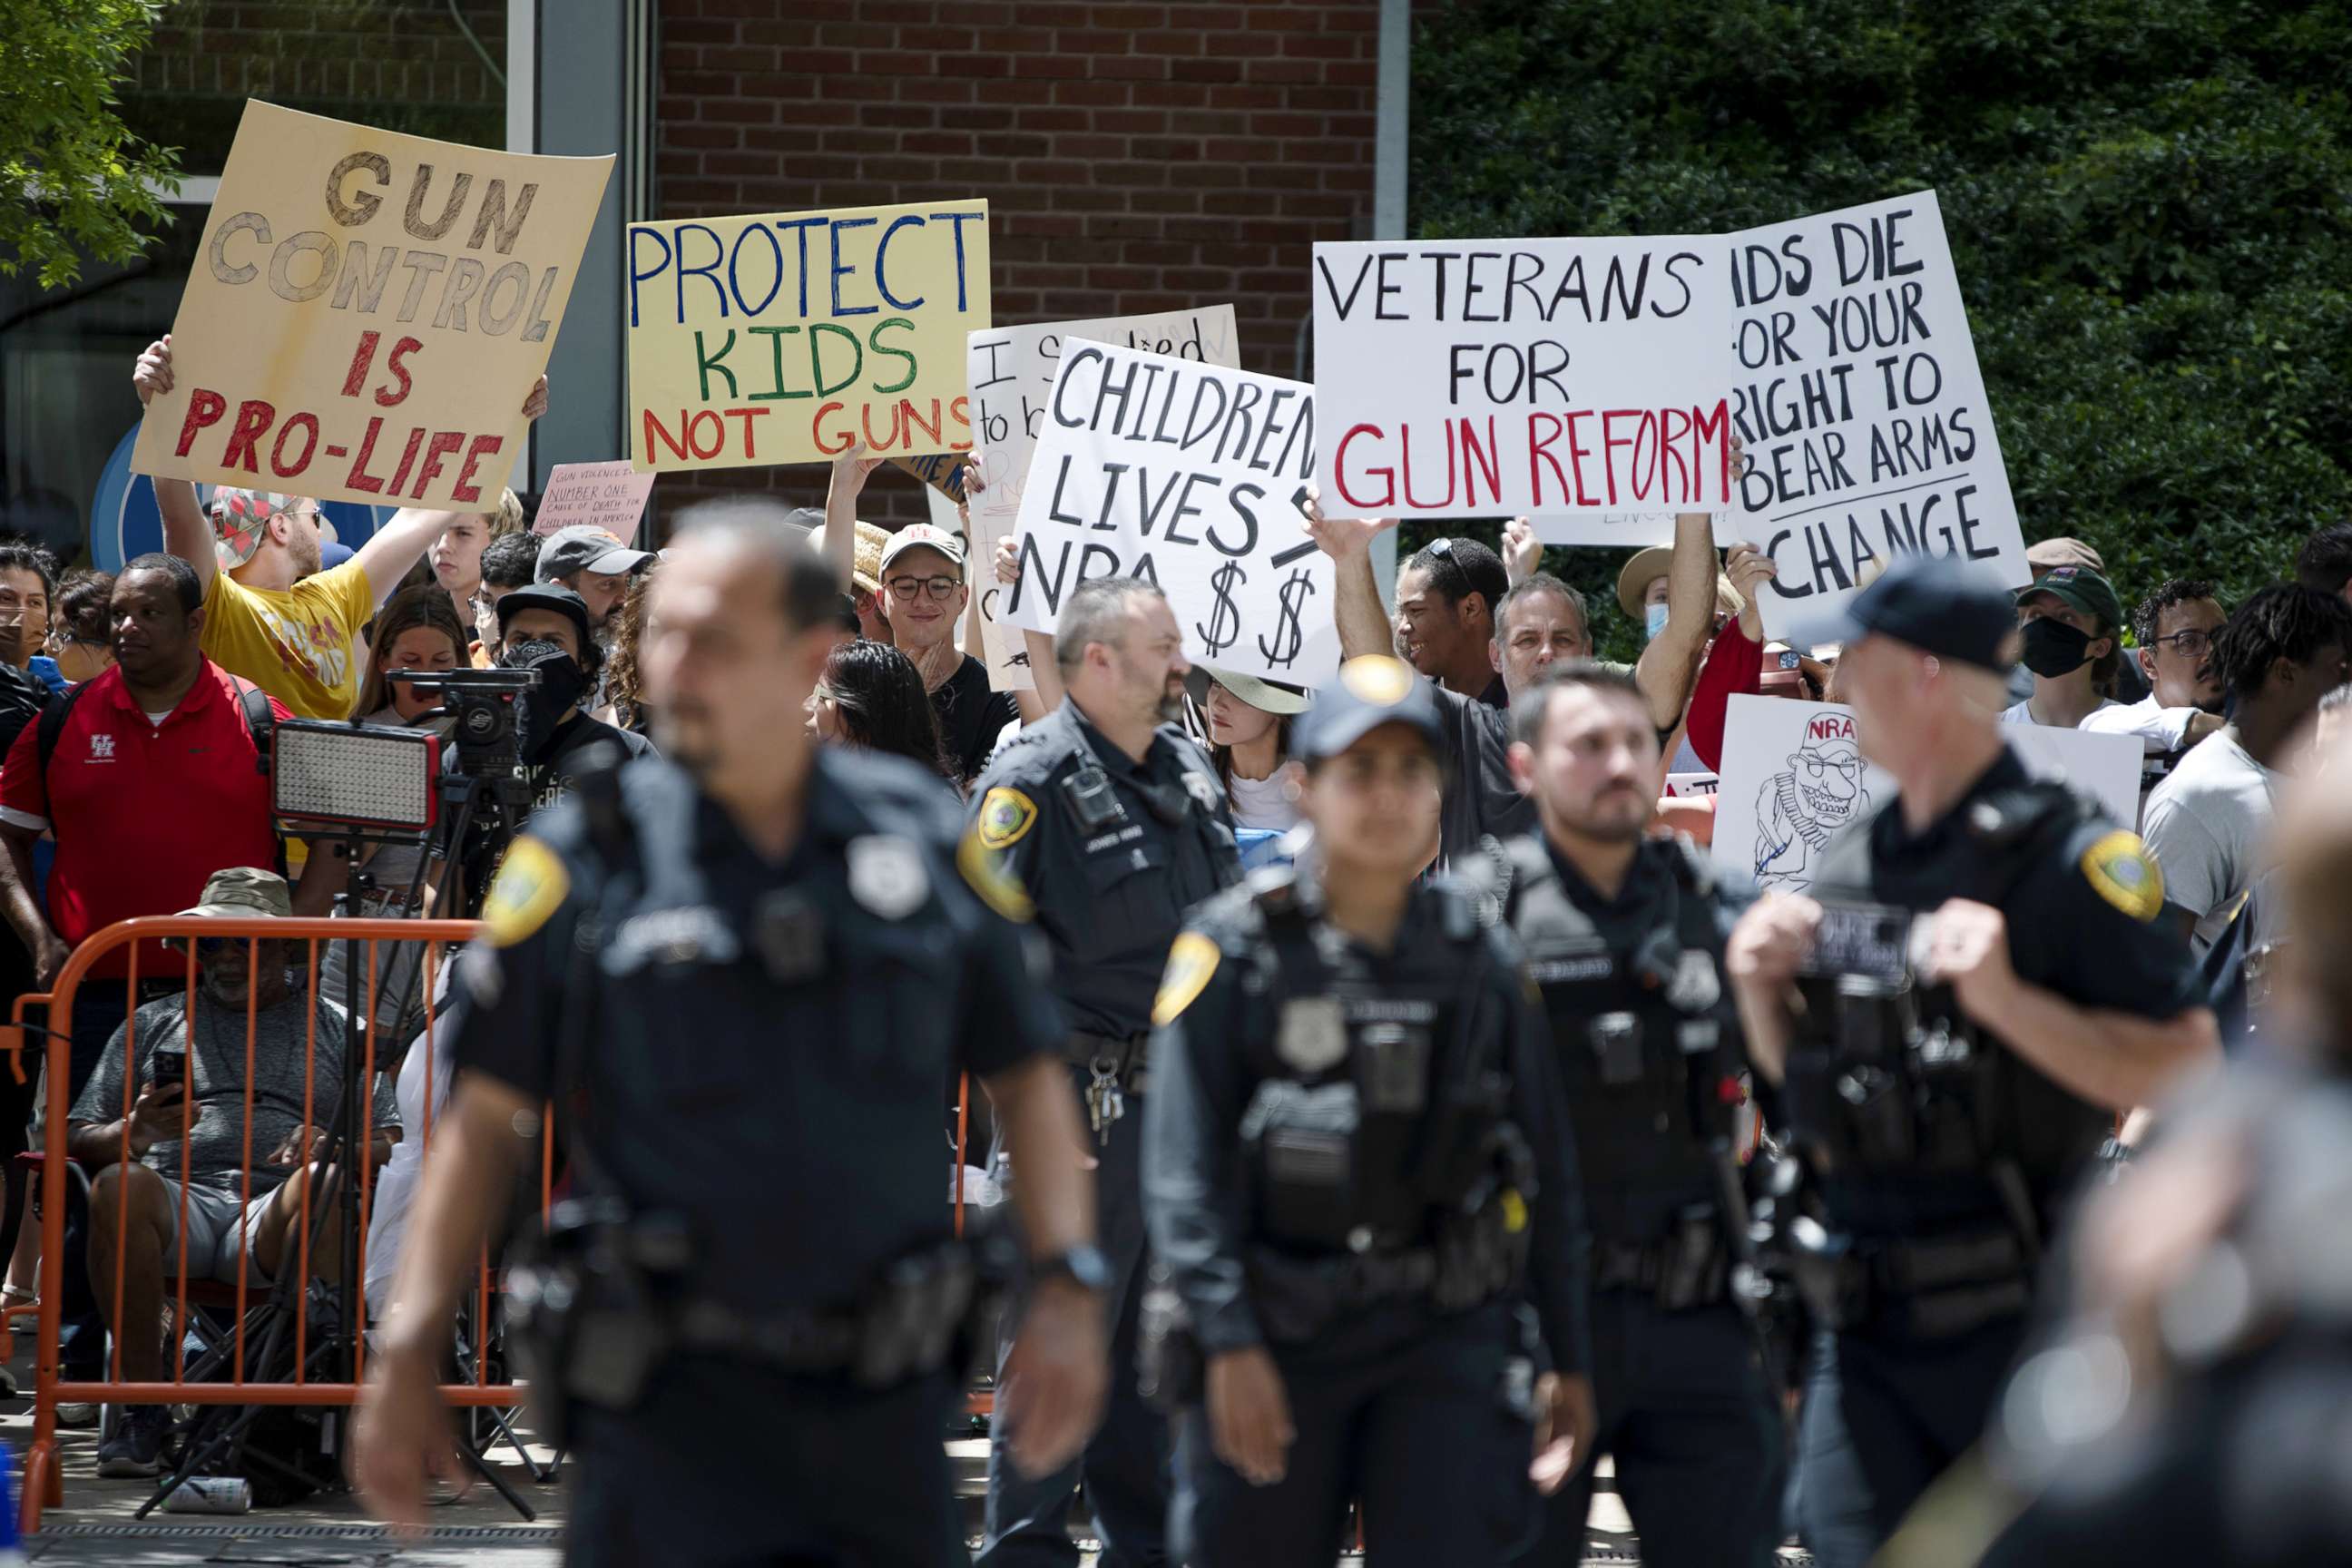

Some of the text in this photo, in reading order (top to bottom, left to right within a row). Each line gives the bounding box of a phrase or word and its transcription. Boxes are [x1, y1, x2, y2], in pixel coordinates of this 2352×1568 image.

[326, 151, 538, 254] GUN
[209, 212, 559, 342] CONTROL
[630, 212, 984, 327] PROTECT
[1318, 252, 1703, 322] VETERANS
[1730, 210, 1924, 307] IDS DIE
[694, 318, 916, 400] KIDS
[974, 341, 1015, 389] I
[1731, 281, 1930, 369] OR YOUR
[341, 330, 424, 407] IS
[1451, 339, 1570, 404] FOR
[1733, 352, 1941, 445] RIGHT TO
[175, 388, 504, 503] PRO-LIFE
[643, 396, 973, 464] NOT GUNS
[979, 399, 1008, 444] to
[1054, 348, 1316, 479] CHILDREN
[1335, 398, 1730, 508] GUN REFORM
[548, 485, 628, 501] NUMBER ONE
[554, 472, 575, 483] GUN
[581, 468, 621, 479] VIOLENCE
[1740, 407, 1975, 512] BEAR ARMS
[540, 518, 583, 529] CHILDREN
[602, 514, 633, 524] AMERICA
[546, 504, 572, 513] CAUSE
[577, 503, 587, 511] OF
[593, 501, 621, 511] DEATH
[1049, 455, 1266, 557] LIVES
[1768, 485, 2000, 599] CHANGE
[1809, 718, 1855, 740] NRA
